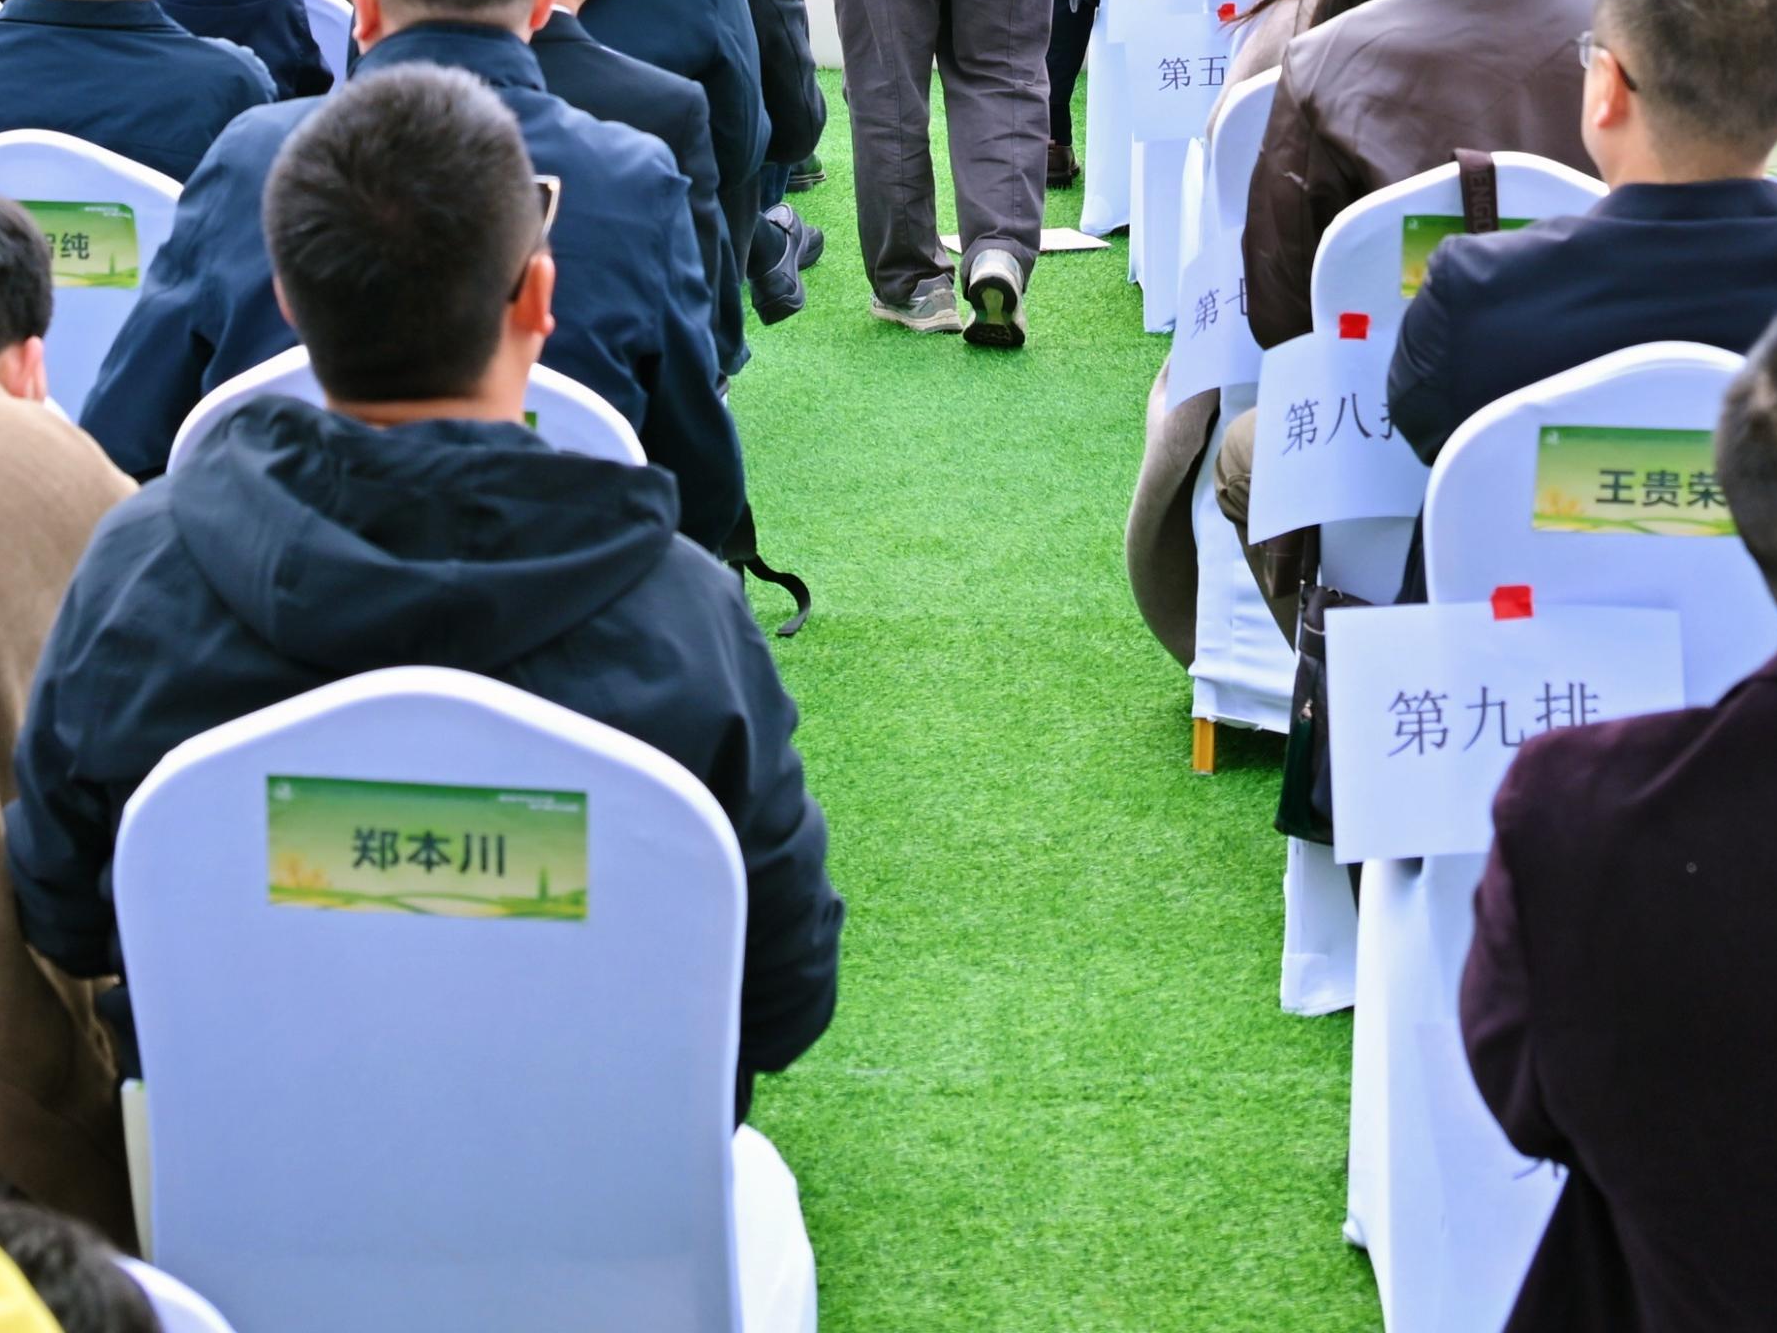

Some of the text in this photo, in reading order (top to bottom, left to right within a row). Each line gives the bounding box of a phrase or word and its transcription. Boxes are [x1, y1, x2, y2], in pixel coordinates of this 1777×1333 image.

[1595, 468, 1728, 510] 王贵荣
[350, 827, 508, 878] 郑本川
